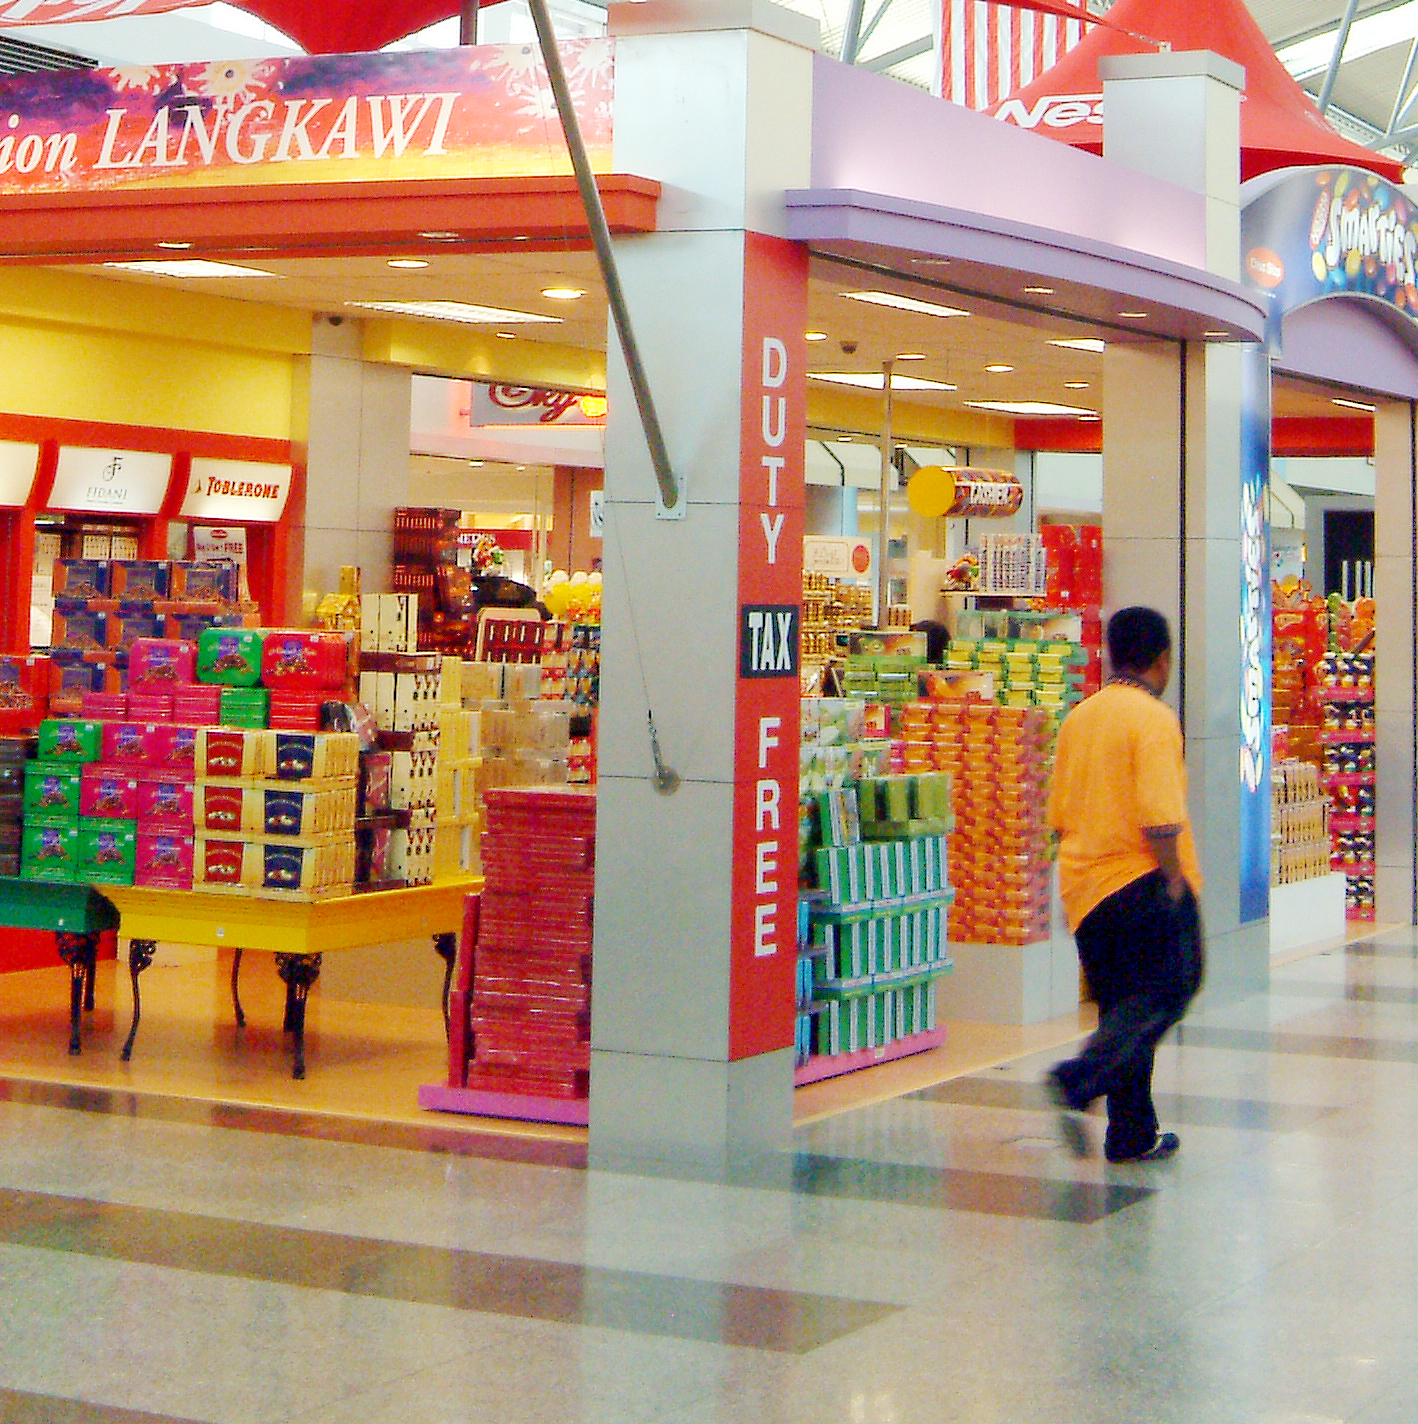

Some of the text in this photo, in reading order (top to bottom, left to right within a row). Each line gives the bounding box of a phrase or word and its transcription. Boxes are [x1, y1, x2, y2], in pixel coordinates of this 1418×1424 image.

[94, 91, 462, 170] LANGKAWI
[207, 476, 281, 499] TOBLERONE
[747, 336, 795, 958] DUTY TAX FREE
